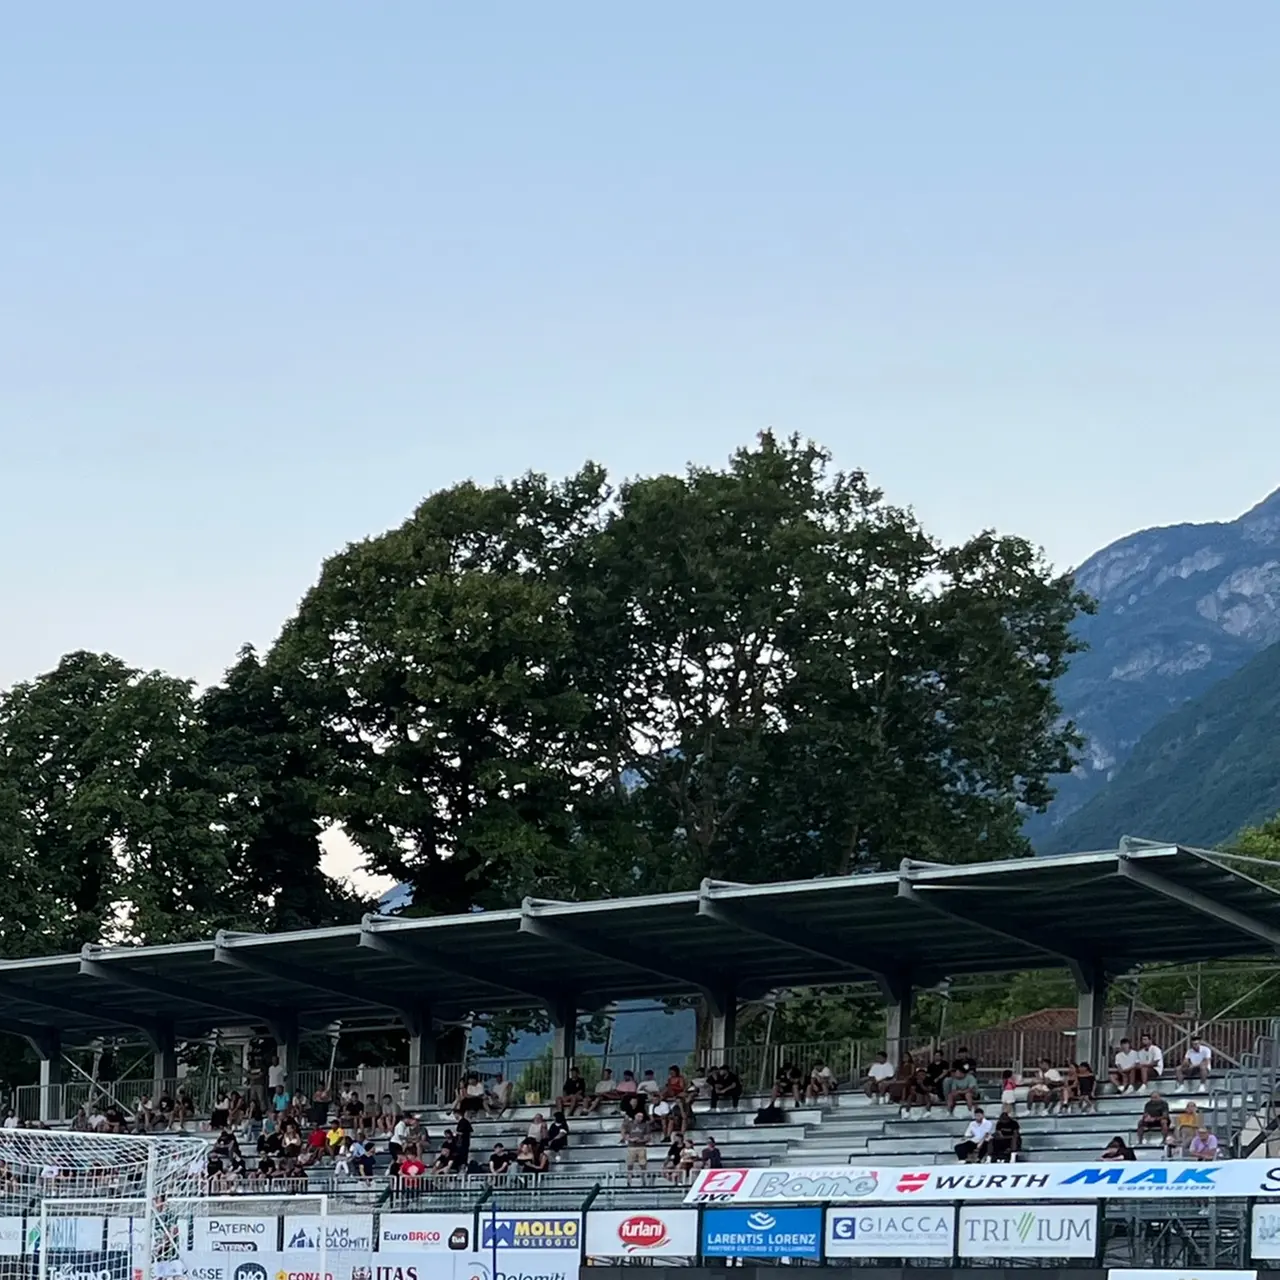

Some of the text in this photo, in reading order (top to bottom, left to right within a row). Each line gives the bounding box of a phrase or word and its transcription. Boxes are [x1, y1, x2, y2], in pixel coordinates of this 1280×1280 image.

[935, 1167, 1224, 1189] WÜRTH MAK
[208, 1220, 266, 1236] PATERNO
[514, 1221, 578, 1236] MOLLO
[622, 1220, 663, 1238] furlani
[859, 1216, 949, 1232] GIACCA
[964, 1211, 1093, 1244] TRIVIUM
[707, 1233, 817, 1245] LARENTIS LORENZ
